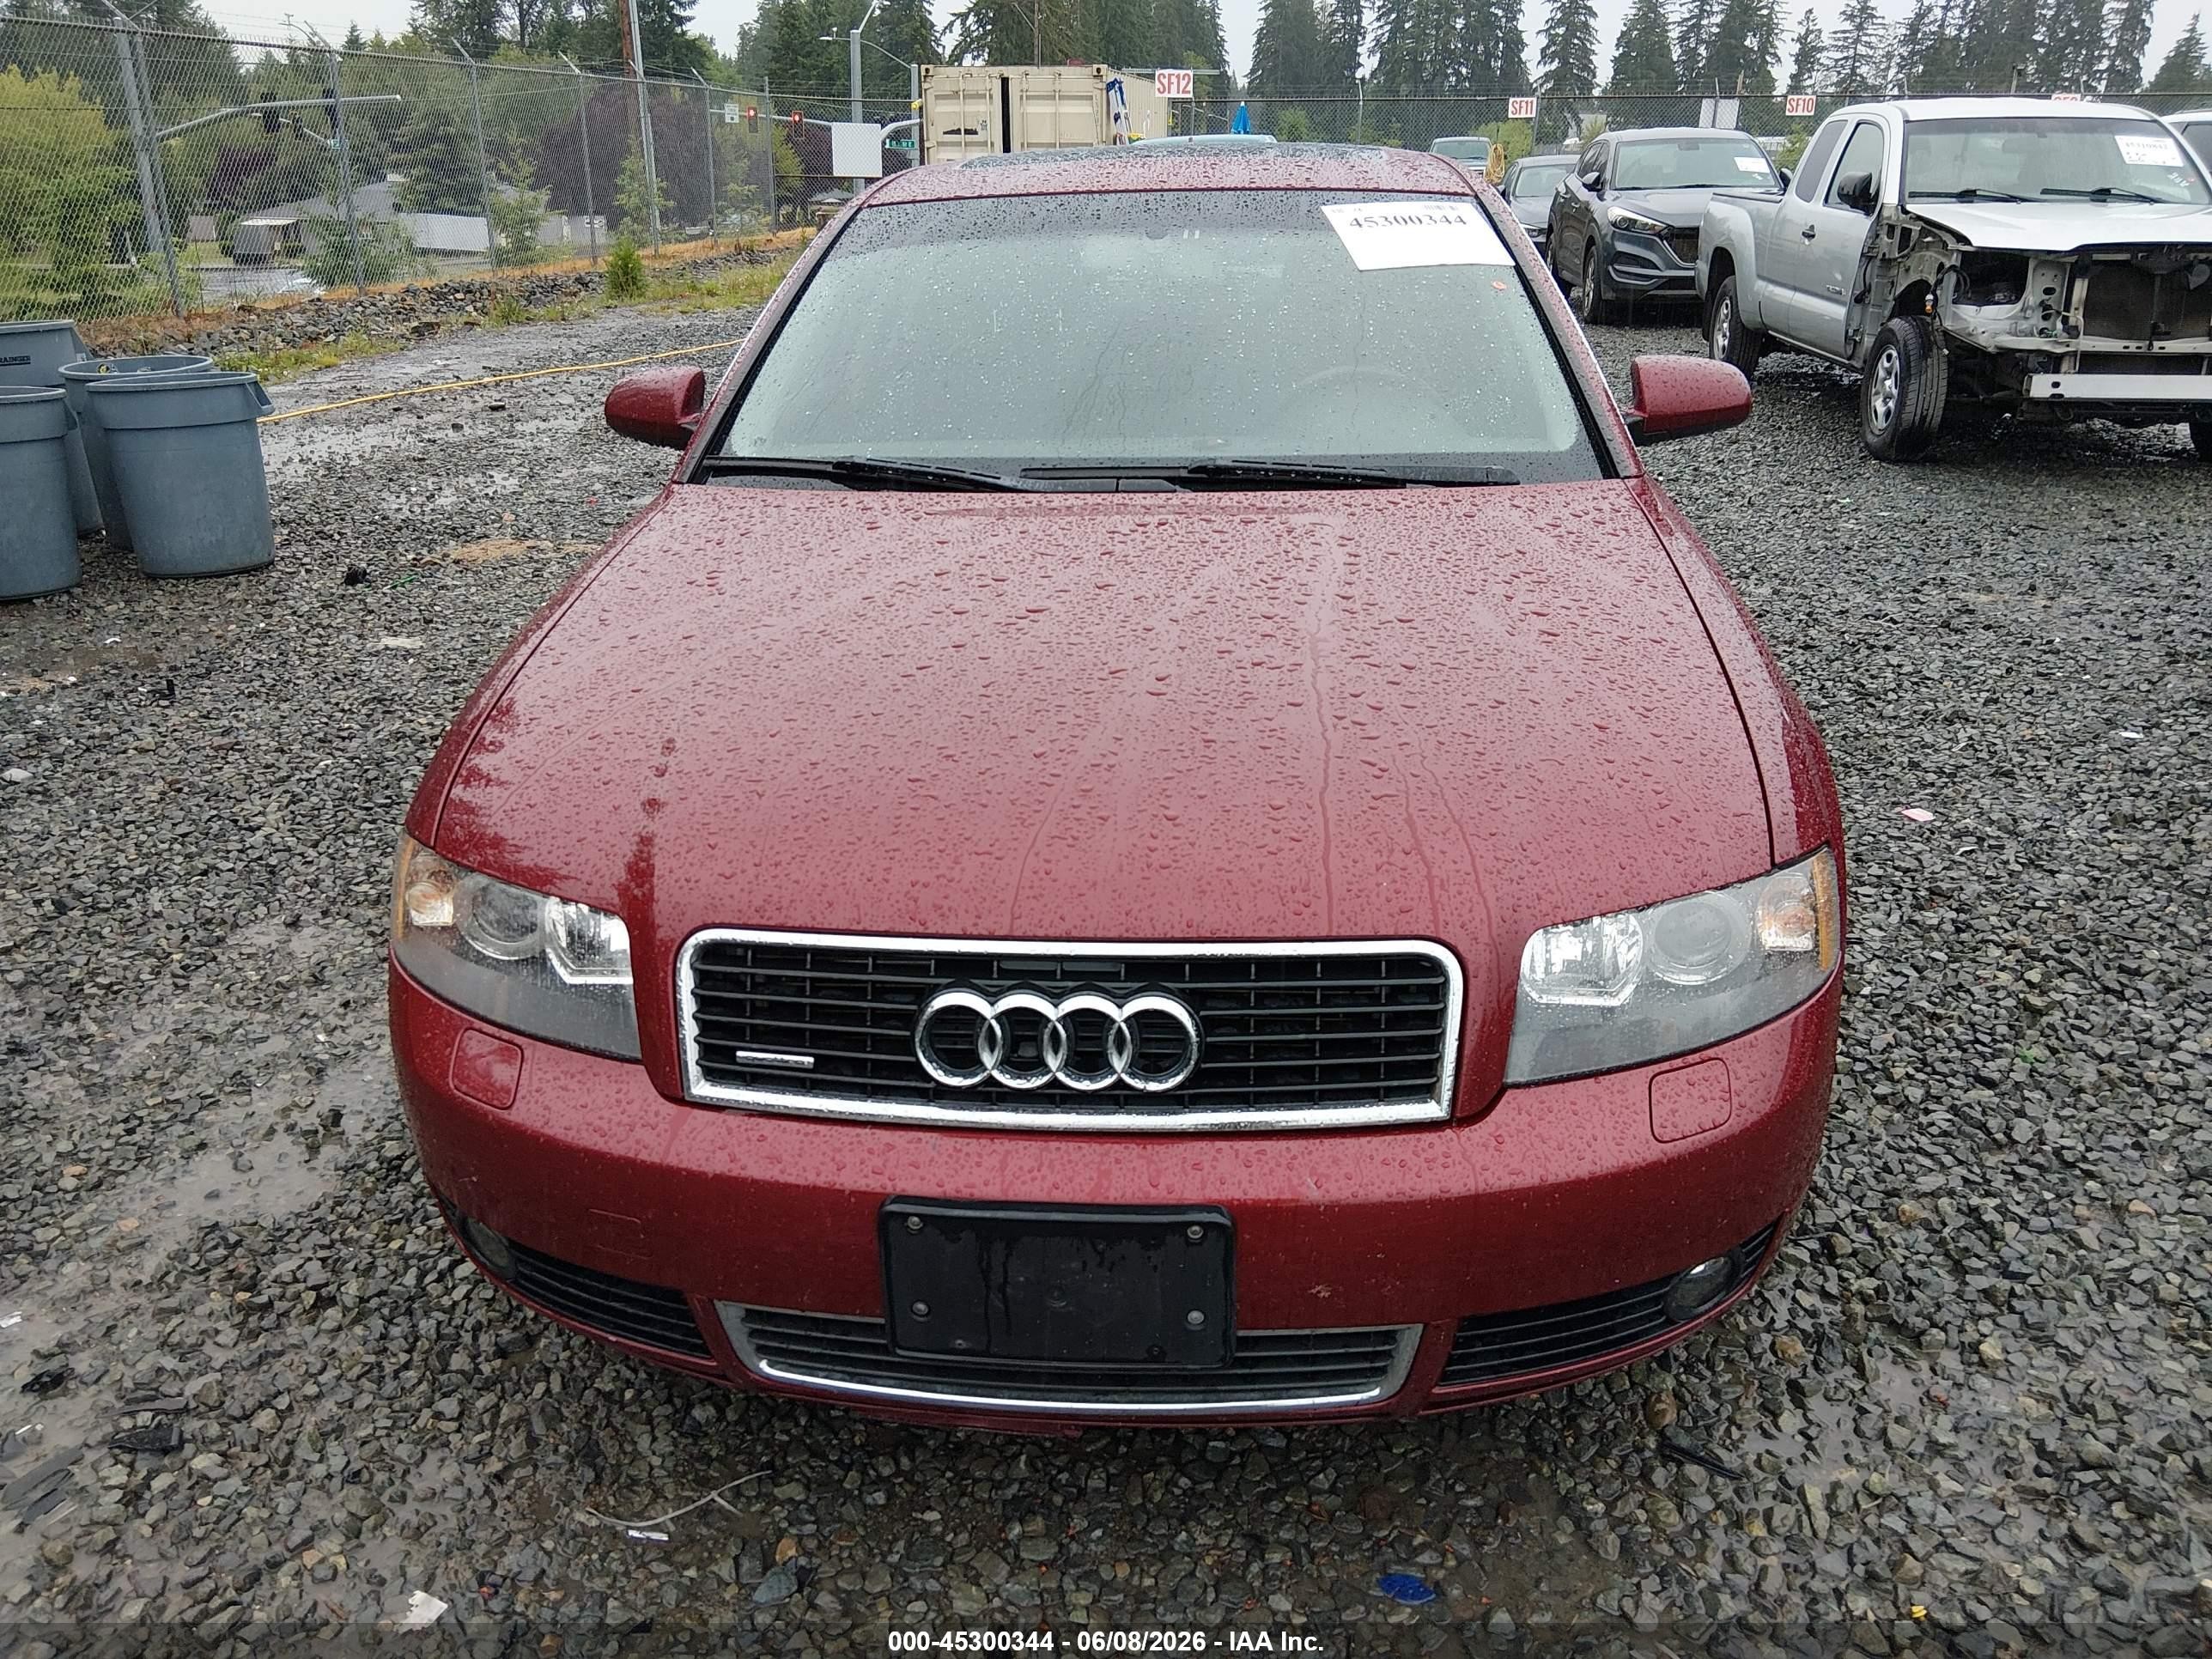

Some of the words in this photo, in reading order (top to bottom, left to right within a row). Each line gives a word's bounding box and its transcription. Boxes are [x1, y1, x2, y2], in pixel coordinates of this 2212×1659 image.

[1157, 73, 1191, 94] SF12
[1511, 100, 1534, 116] SF11
[1788, 98, 1814, 112] SF10
[1349, 215, 1467, 228] 45300344
